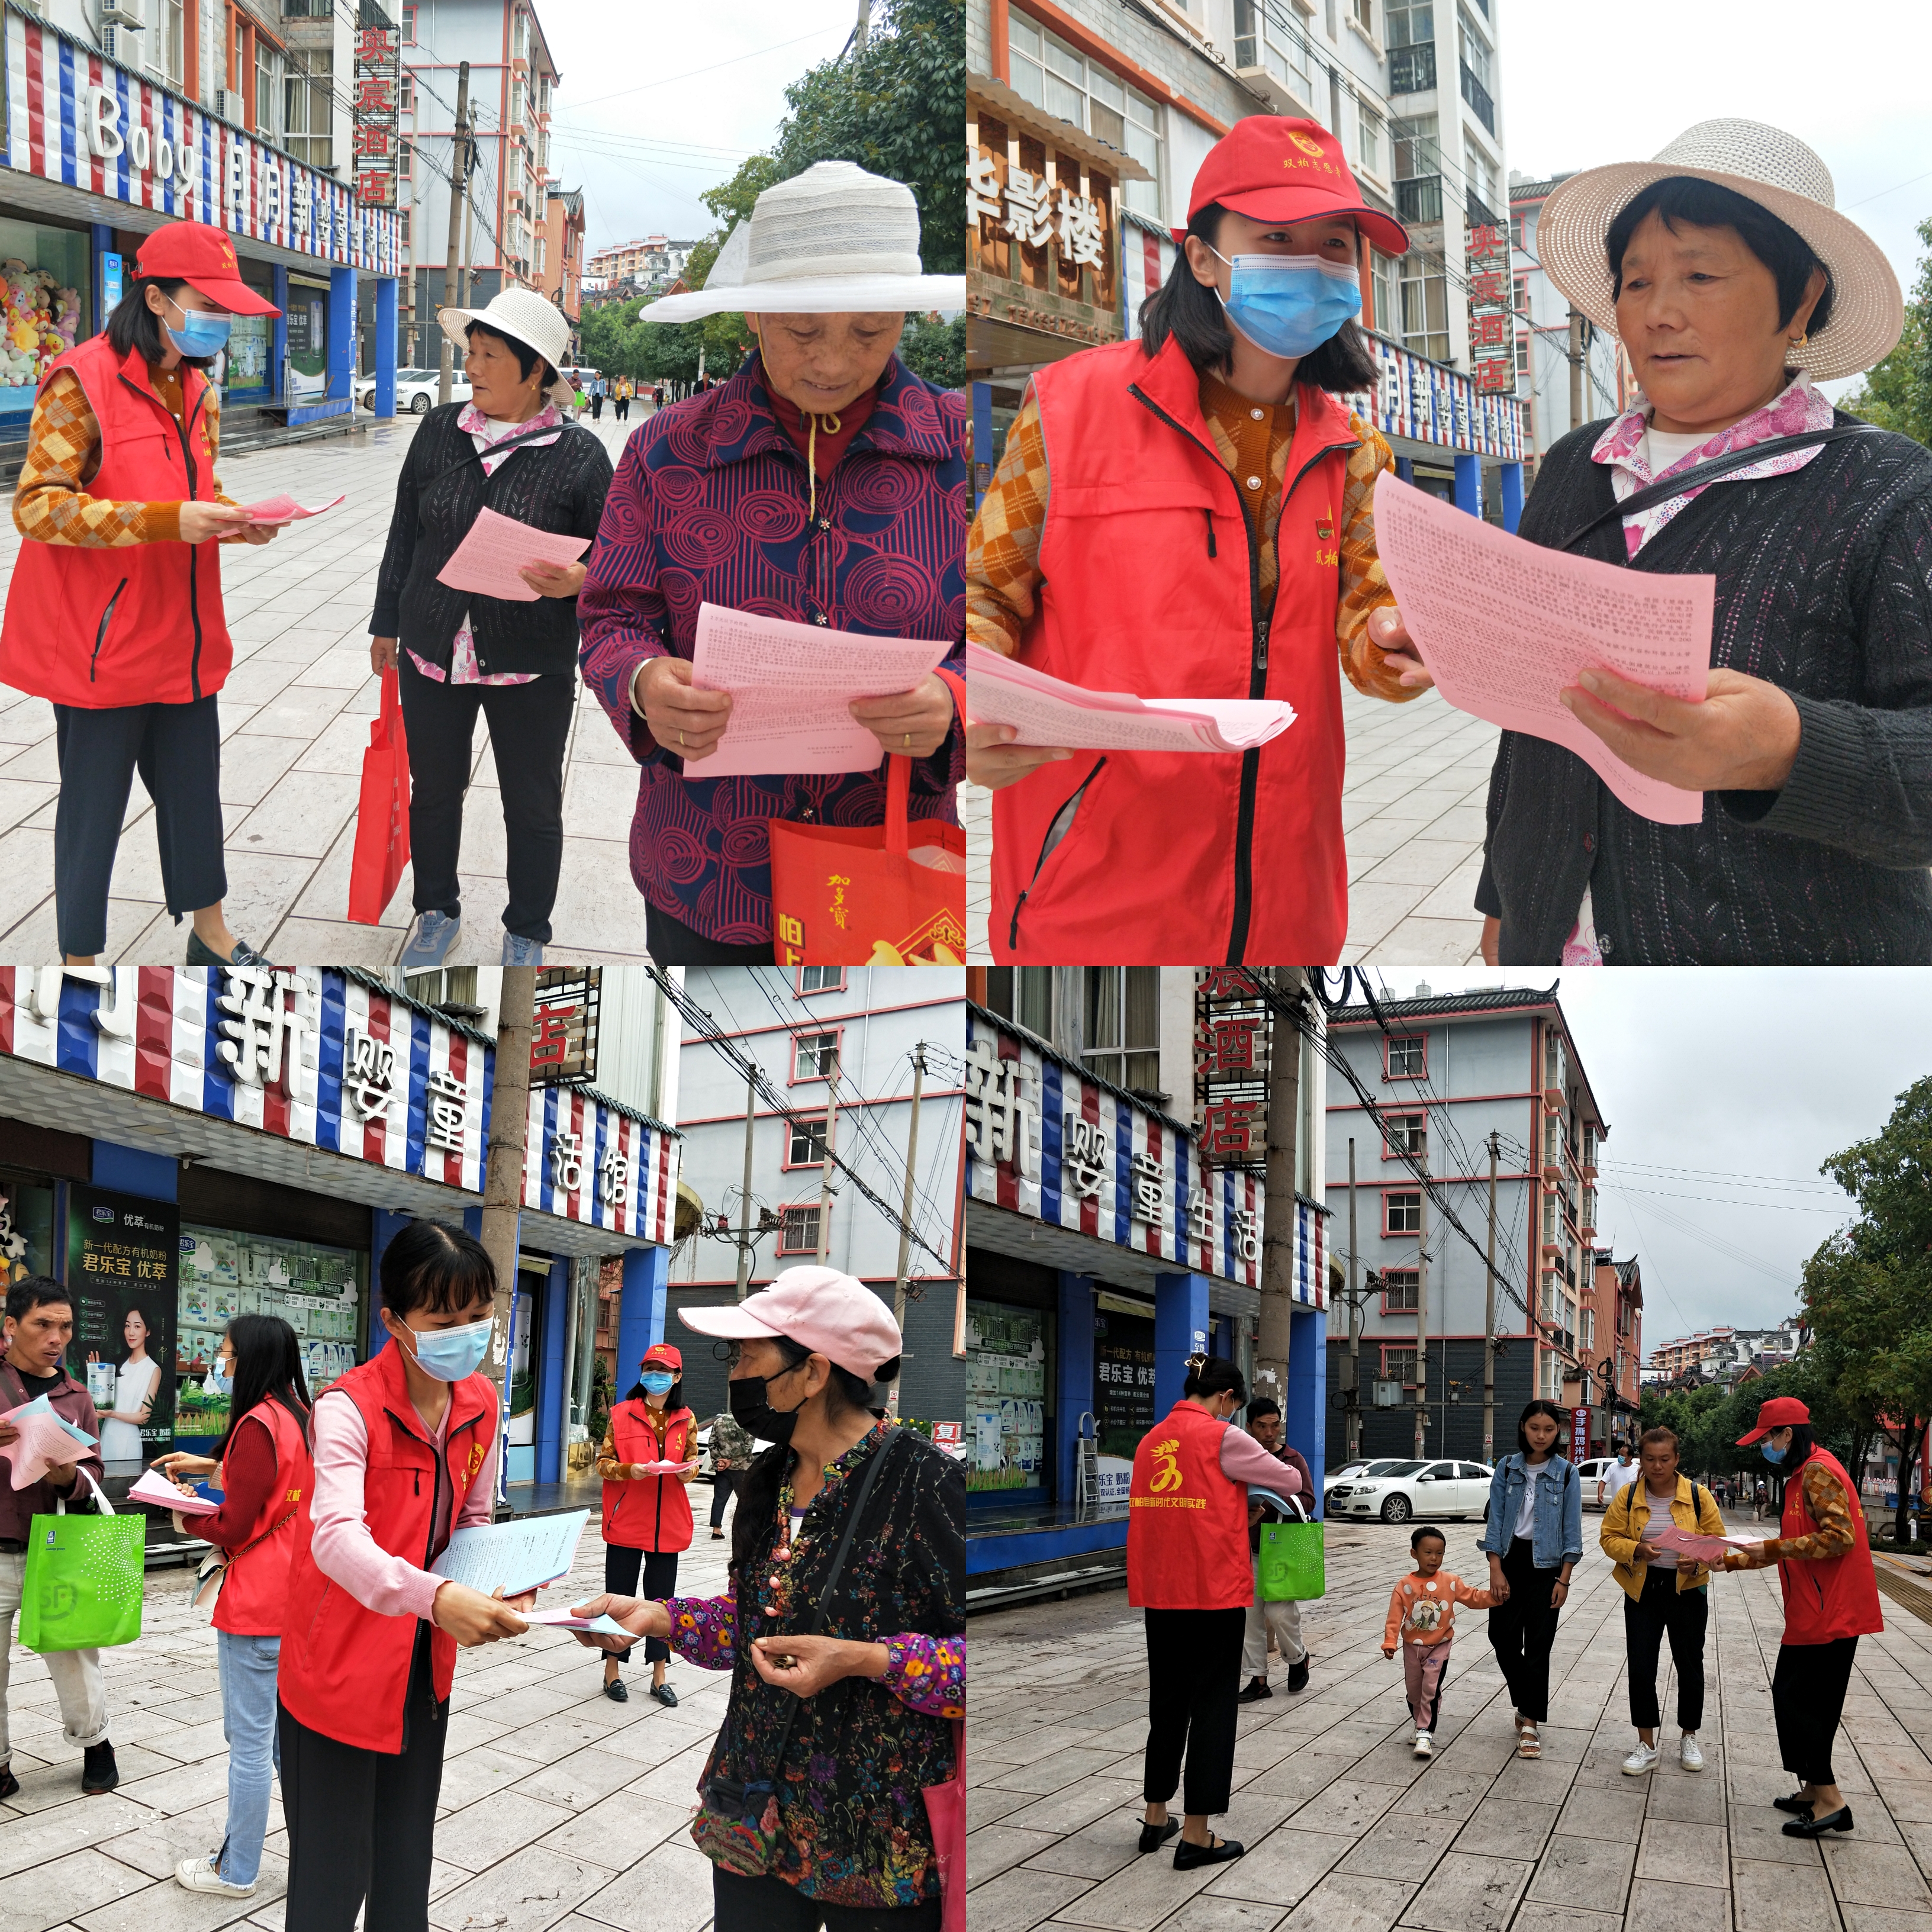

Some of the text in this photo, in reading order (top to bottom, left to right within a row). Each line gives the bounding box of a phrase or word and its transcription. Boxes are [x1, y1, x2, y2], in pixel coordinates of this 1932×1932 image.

[353, 26, 394, 201] 奥宸酒店
[86, 86, 195, 196] Baby
[1283, 157, 1341, 178] 双柏志愿者
[1467, 224, 1507, 389] 奥宸酒店
[95, 1208, 112, 1217] 君乐宝
[124, 1213, 165, 1232] 优萃 有机奶粉
[83, 1239, 167, 1261] 新一代配方有机奶粉
[83, 1252, 167, 1280] 君乐宝 优萃
[1099, 1362, 1134, 1383] 君乐宝
[139, 1429, 157, 1437] 君乐宝
[1116, 1472, 1130, 1485] 奶粉
[1129, 1497, 1207, 1509] 双柏县新时代文明实践
